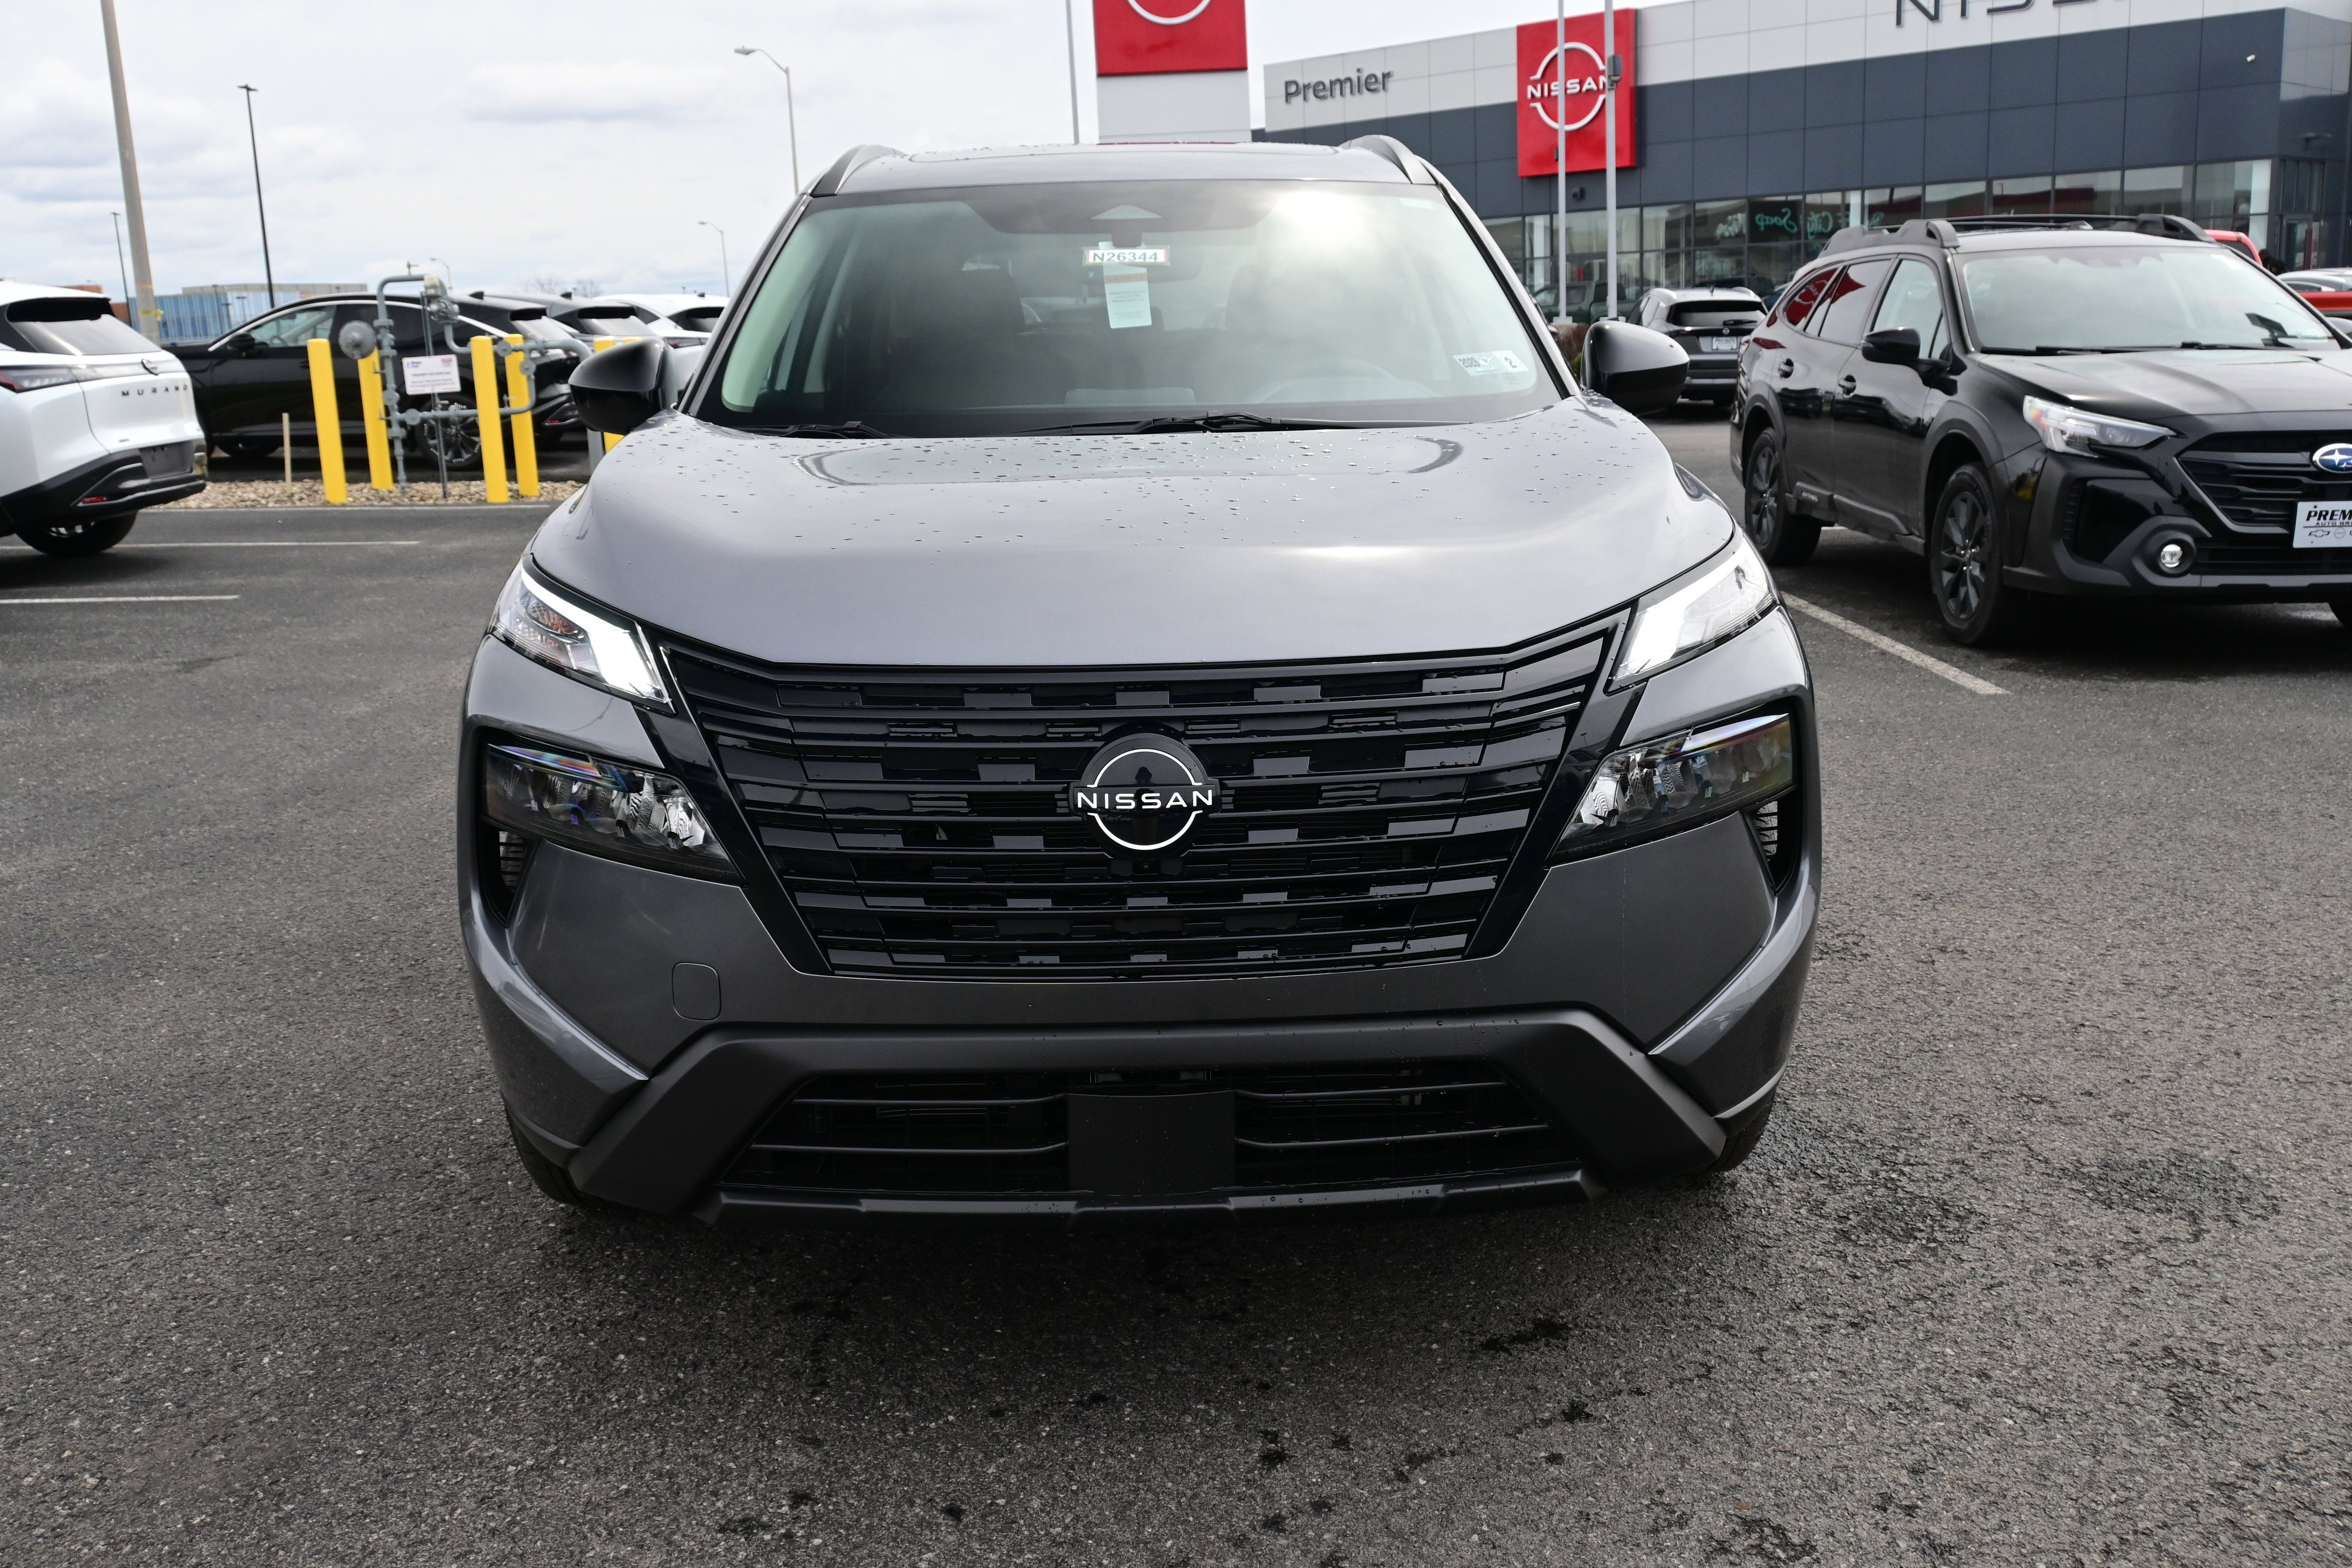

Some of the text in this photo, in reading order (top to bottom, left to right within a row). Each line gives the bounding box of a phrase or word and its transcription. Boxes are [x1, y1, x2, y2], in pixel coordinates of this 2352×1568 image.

[1285, 68, 1392, 103] Premier
[1093, 252, 1158, 261] N26344
[1504, 357, 1518, 368] 2
[121, 384, 187, 396] MURANO
[1077, 789, 1212, 809] NISSAN
